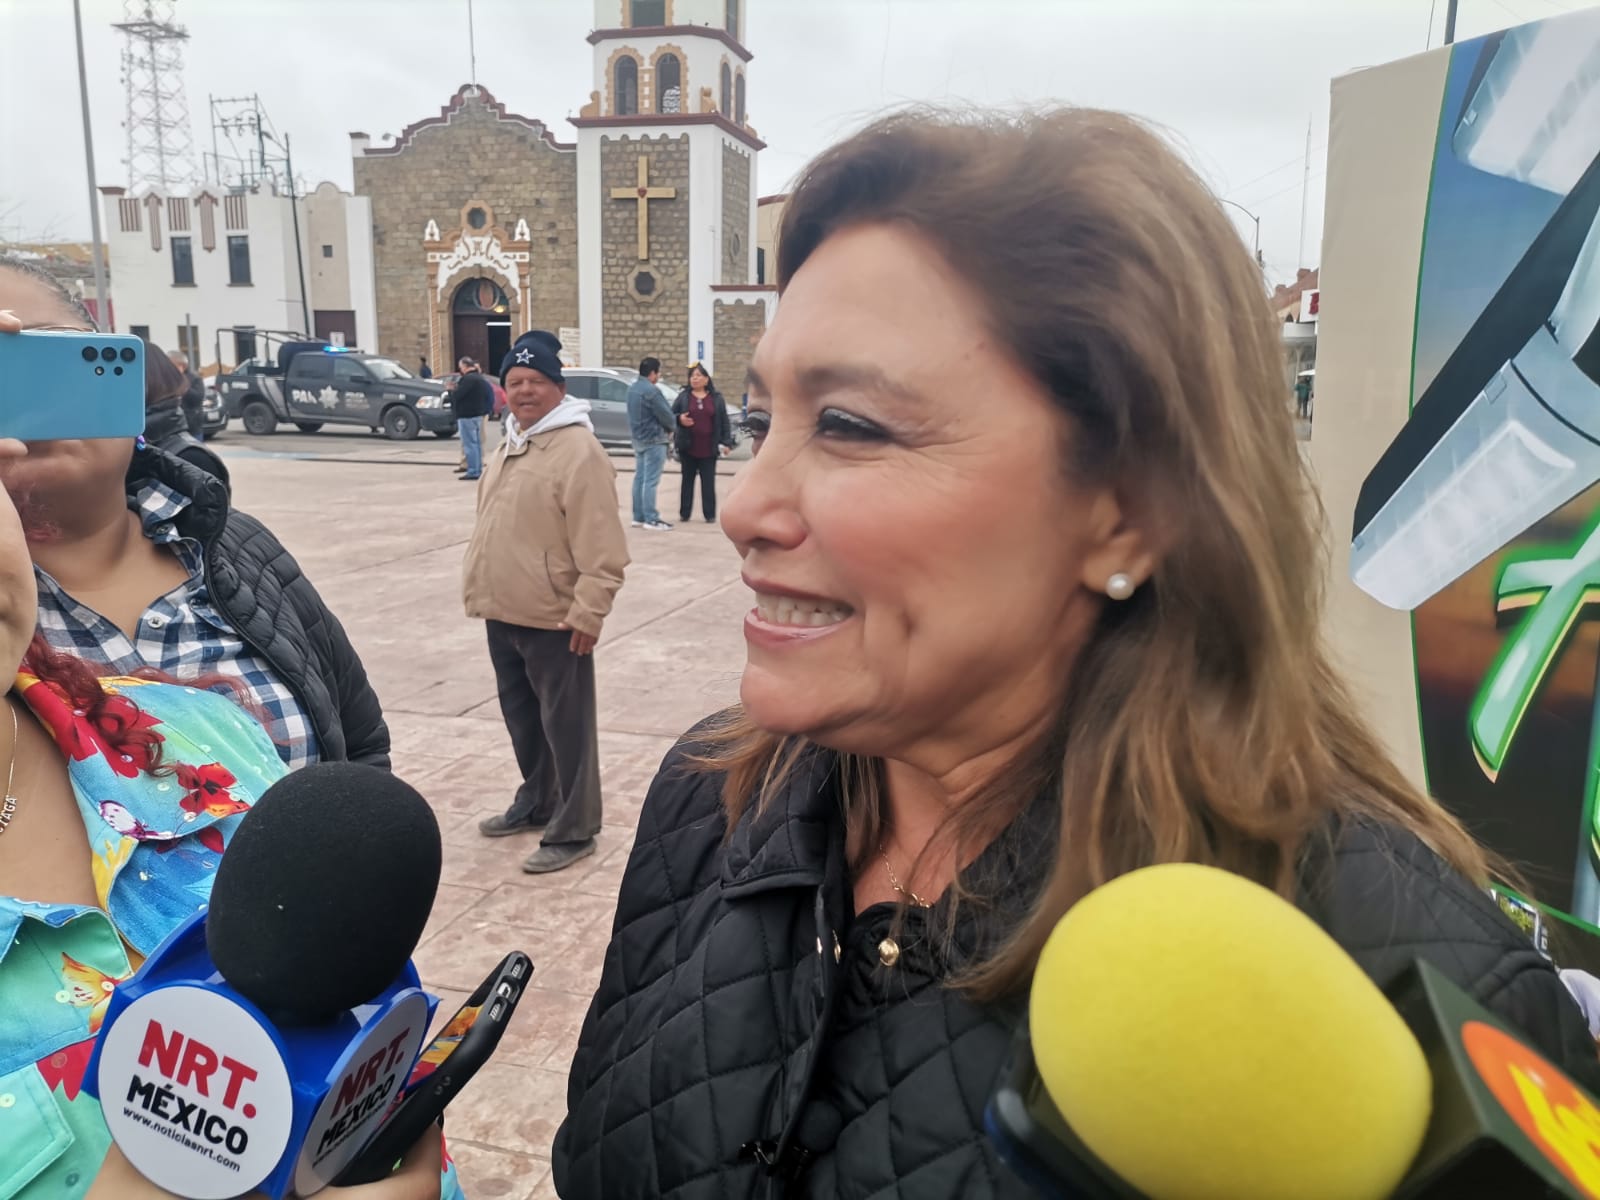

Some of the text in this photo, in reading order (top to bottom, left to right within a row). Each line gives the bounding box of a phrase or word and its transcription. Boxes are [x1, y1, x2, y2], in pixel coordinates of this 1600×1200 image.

[138, 1018, 258, 1119] NRT.
[330, 1027, 410, 1120] NRT.
[123, 1106, 241, 1173] www.noticiasnrt.com
[126, 1074, 248, 1155] MÉXICO
[316, 1073, 396, 1156] MÉXICO
